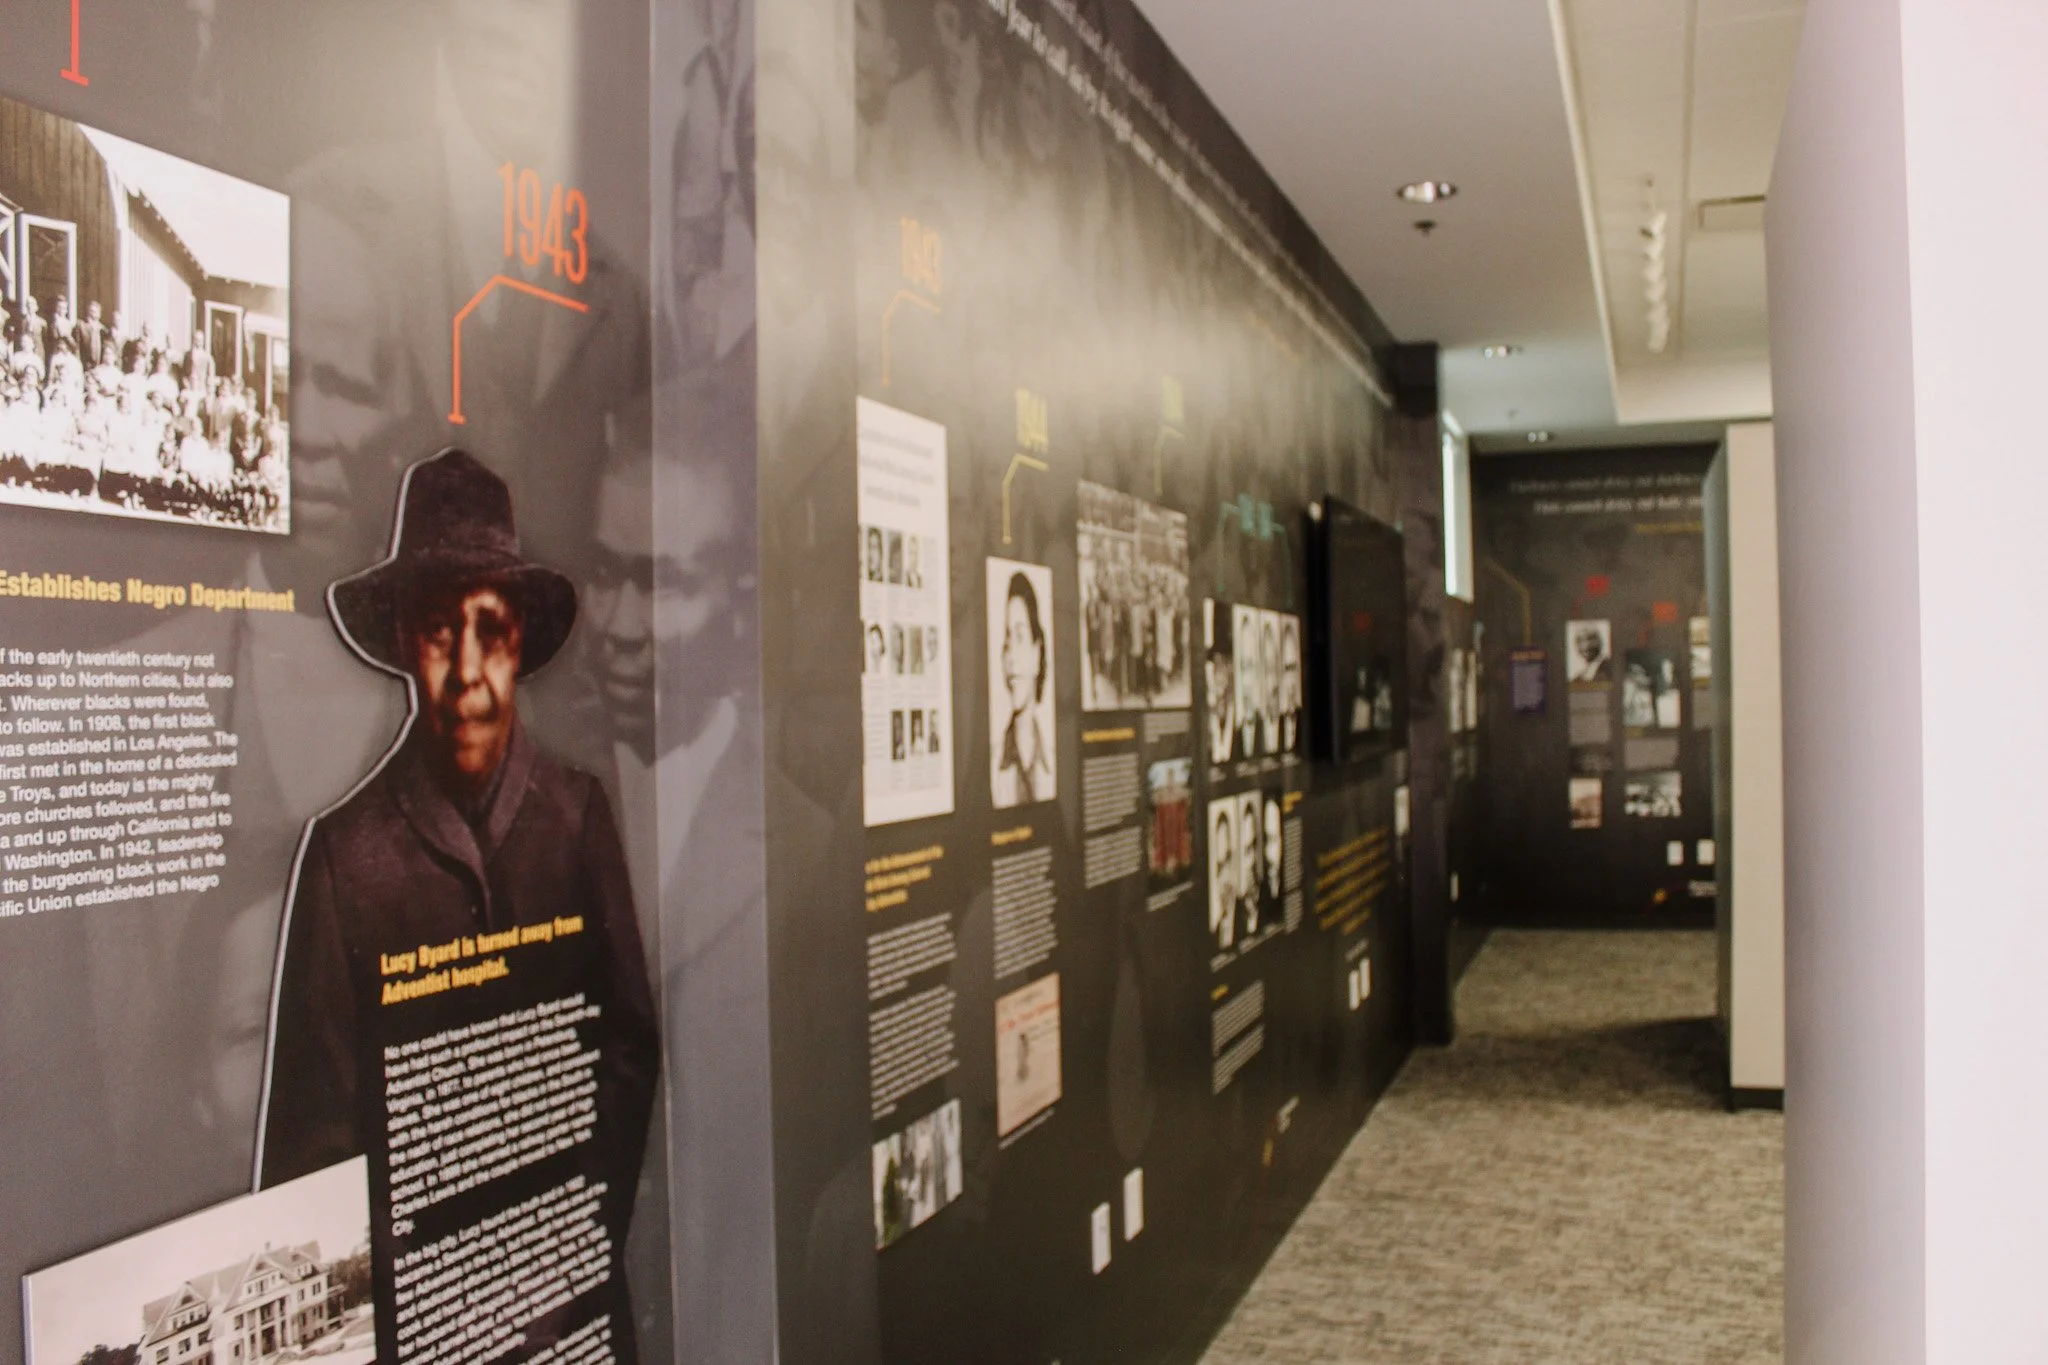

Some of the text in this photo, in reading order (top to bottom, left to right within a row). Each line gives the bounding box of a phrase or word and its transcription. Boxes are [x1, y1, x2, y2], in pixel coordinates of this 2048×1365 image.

[497, 160, 588, 284] 1943
[0, 570, 295, 612] Establishes Negro Department
[9, 649, 34, 664] the
[37, 650, 72, 669] early
[76, 651, 140, 666] twentieth
[143, 652, 191, 670] century
[37, 674, 57, 690] up
[60, 672, 75, 687] to
[79, 671, 140, 687] Northern
[183, 673, 205, 688] but
[207, 673, 234, 688] also
[11, 696, 82, 711] Wherever
[85, 694, 132, 710] blacks
[134, 696, 167, 708] were
[168, 693, 210, 708] found,
[17, 718, 64, 733] follow.
[69, 716, 83, 732] In
[129, 715, 150, 730] the
[180, 713, 216, 734] black
[28, 737, 111, 756] established
[115, 736, 128, 751] in
[130, 736, 156, 751] Los
[156, 733, 213, 756] Angeles.
[213, 731, 239, 752] The
[30, 762, 60, 778] met
[63, 761, 77, 775] in
[80, 760, 103, 775] the
[106, 759, 146, 773] home
[148, 755, 163, 771] of
[164, 758, 174, 770] a
[175, 750, 239, 769] dedicated
[11, 786, 56, 804] Troys,
[59, 781, 87, 798] and
[90, 780, 130, 797] today
[133, 778, 146, 792] is
[147, 777, 170, 791] the
[171, 773, 215, 793] mighty
[25, 804, 93, 823] churches
[96, 796, 158, 817] followed,
[160, 795, 187, 812] and
[187, 789, 209, 808] the
[14, 830, 43, 847] and
[47, 830, 67, 846] up
[70, 822, 125, 841] through
[127, 816, 191, 835] California
[191, 812, 217, 829] and
[218, 812, 233, 826] to
[5, 832, 225, 870] Washington. In 1942, leadership
[4, 852, 227, 893] the burgeoning black work in the
[28, 895, 73, 913] Union
[76, 881, 155, 906] established
[156, 879, 179, 894] the
[180, 875, 220, 892] Negro
[380, 916, 584, 974] Lucy Byard is turned away from
[381, 957, 511, 1004] Adventist hospital.
